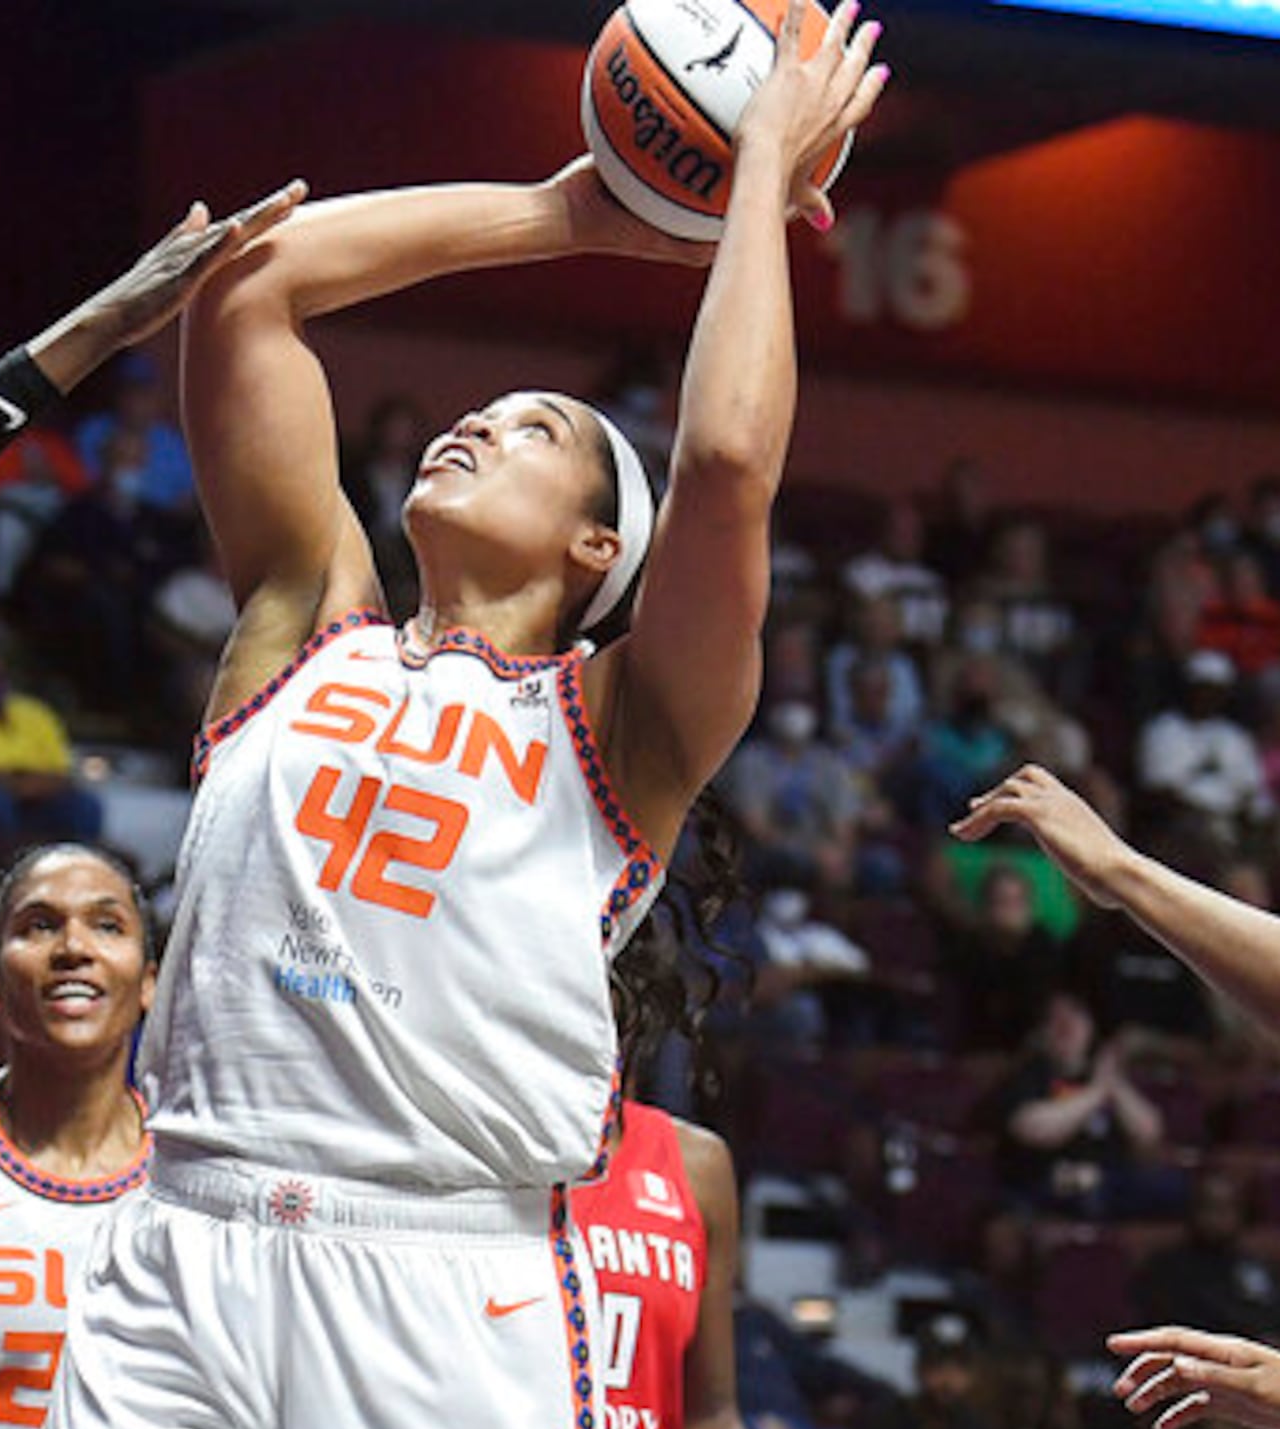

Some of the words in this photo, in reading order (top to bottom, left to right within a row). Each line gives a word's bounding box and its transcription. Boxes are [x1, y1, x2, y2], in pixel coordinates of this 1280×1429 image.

[604, 42, 726, 202] Wilson
[828, 206, 972, 330] 16
[289, 682, 549, 807] SUN
[295, 765, 470, 920] 42
[274, 964, 358, 1006] Health
